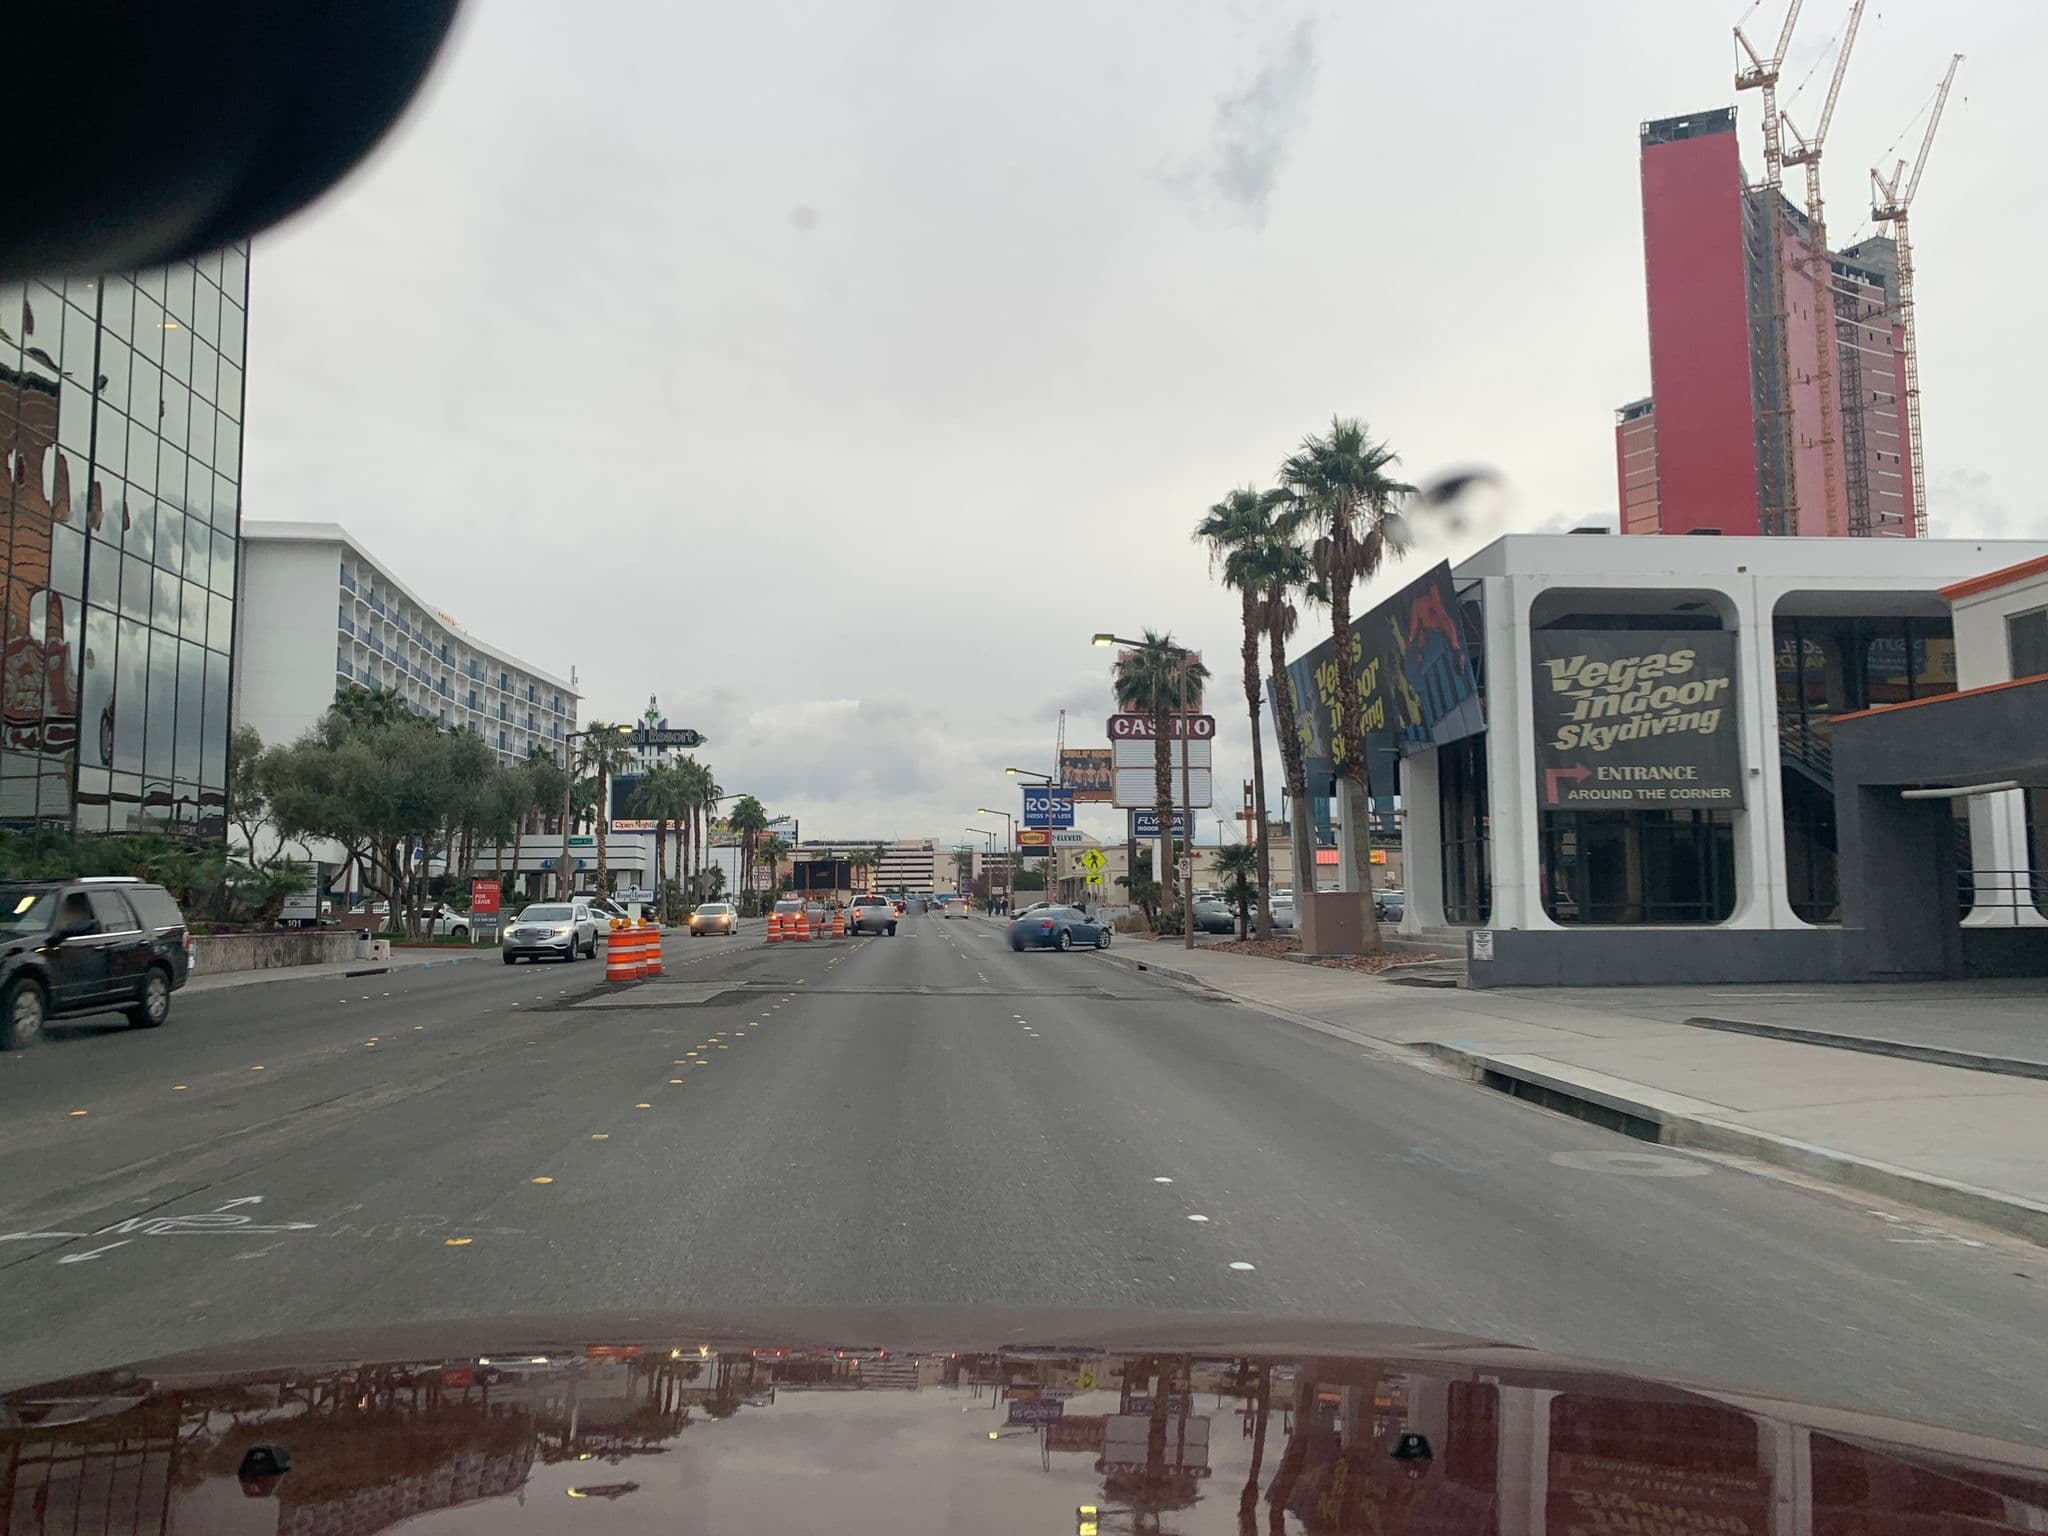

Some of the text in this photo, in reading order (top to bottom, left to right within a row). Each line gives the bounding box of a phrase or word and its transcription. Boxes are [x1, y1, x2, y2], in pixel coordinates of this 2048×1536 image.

[1314, 632, 1362, 704] Ves
[1538, 649, 1697, 694] Vegas
[1114, 718, 1211, 735] CASNO
[1546, 708, 1721, 751] Skydiving
[622, 727, 694, 745] yal Resort
[1597, 766, 1698, 781] ENTRANCE
[1568, 788, 1732, 800] AROUND THE CORNER
[1026, 797, 1072, 811] ROSS
[287, 919, 302, 928] 101
